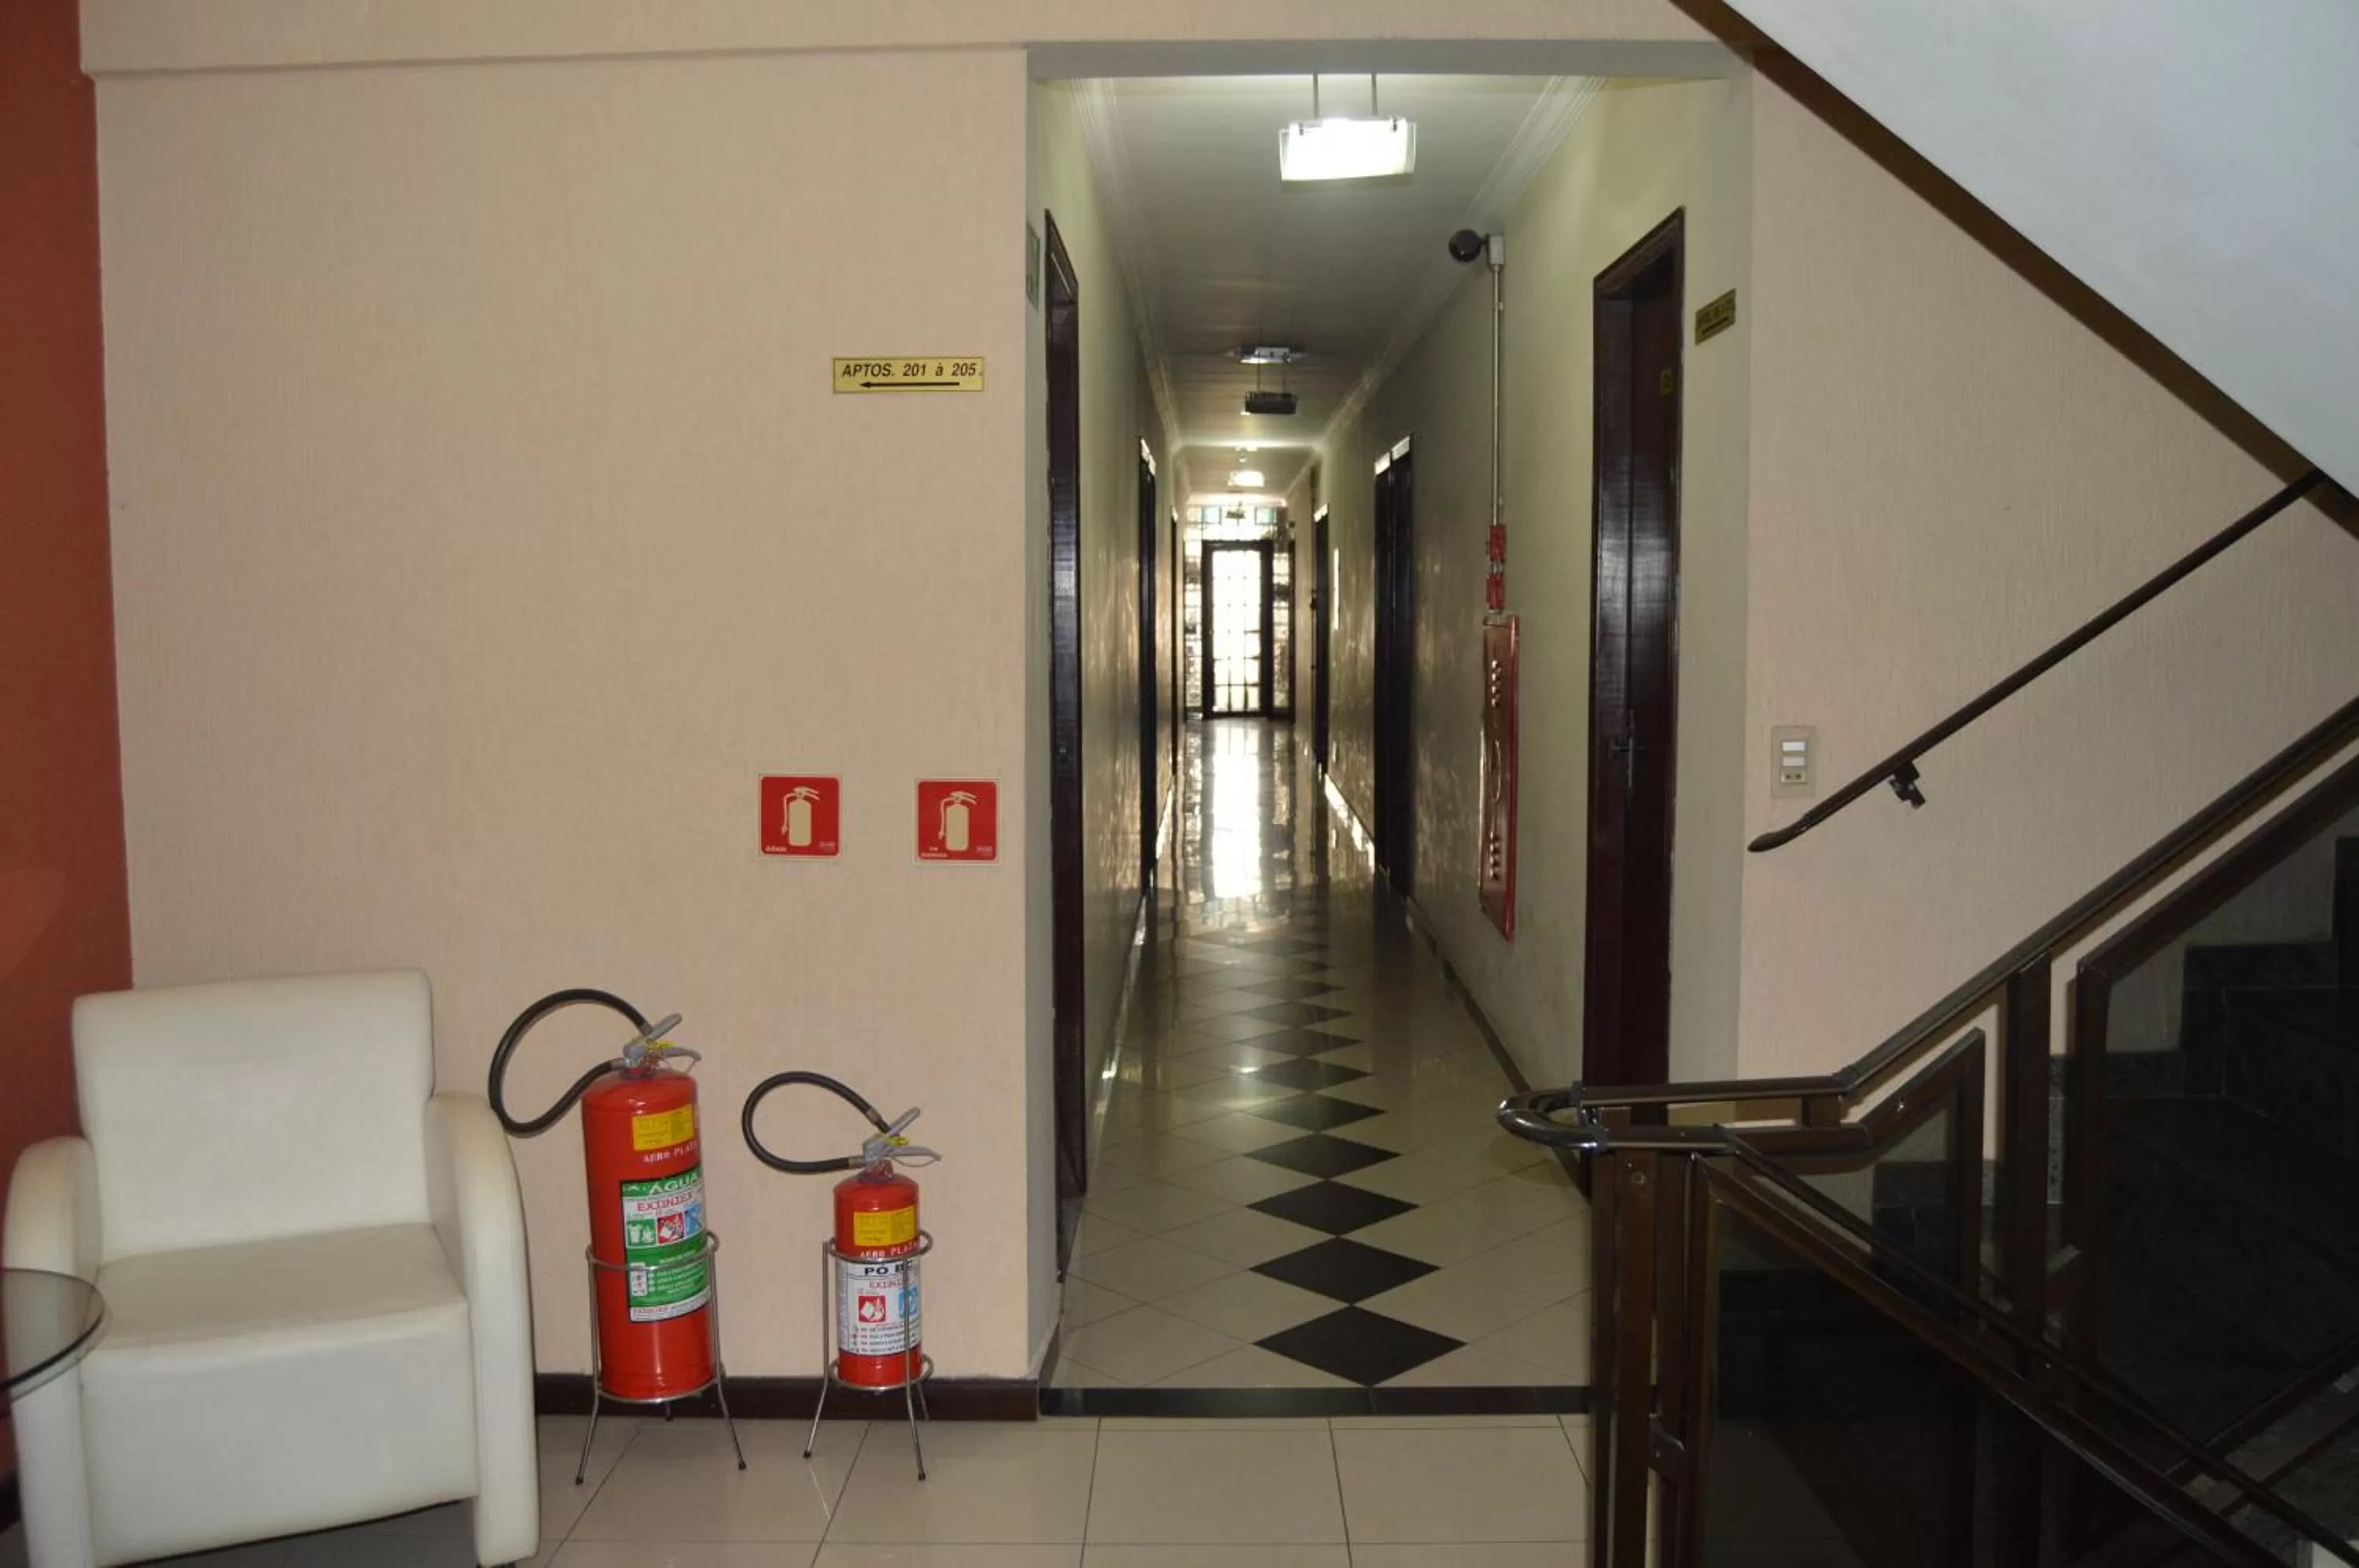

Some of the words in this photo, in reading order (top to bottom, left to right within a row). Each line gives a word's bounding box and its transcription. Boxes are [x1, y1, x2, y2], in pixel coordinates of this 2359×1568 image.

[841, 363, 895, 377] APTOS.
[903, 363, 927, 377] 201
[951, 362, 977, 377] 205
